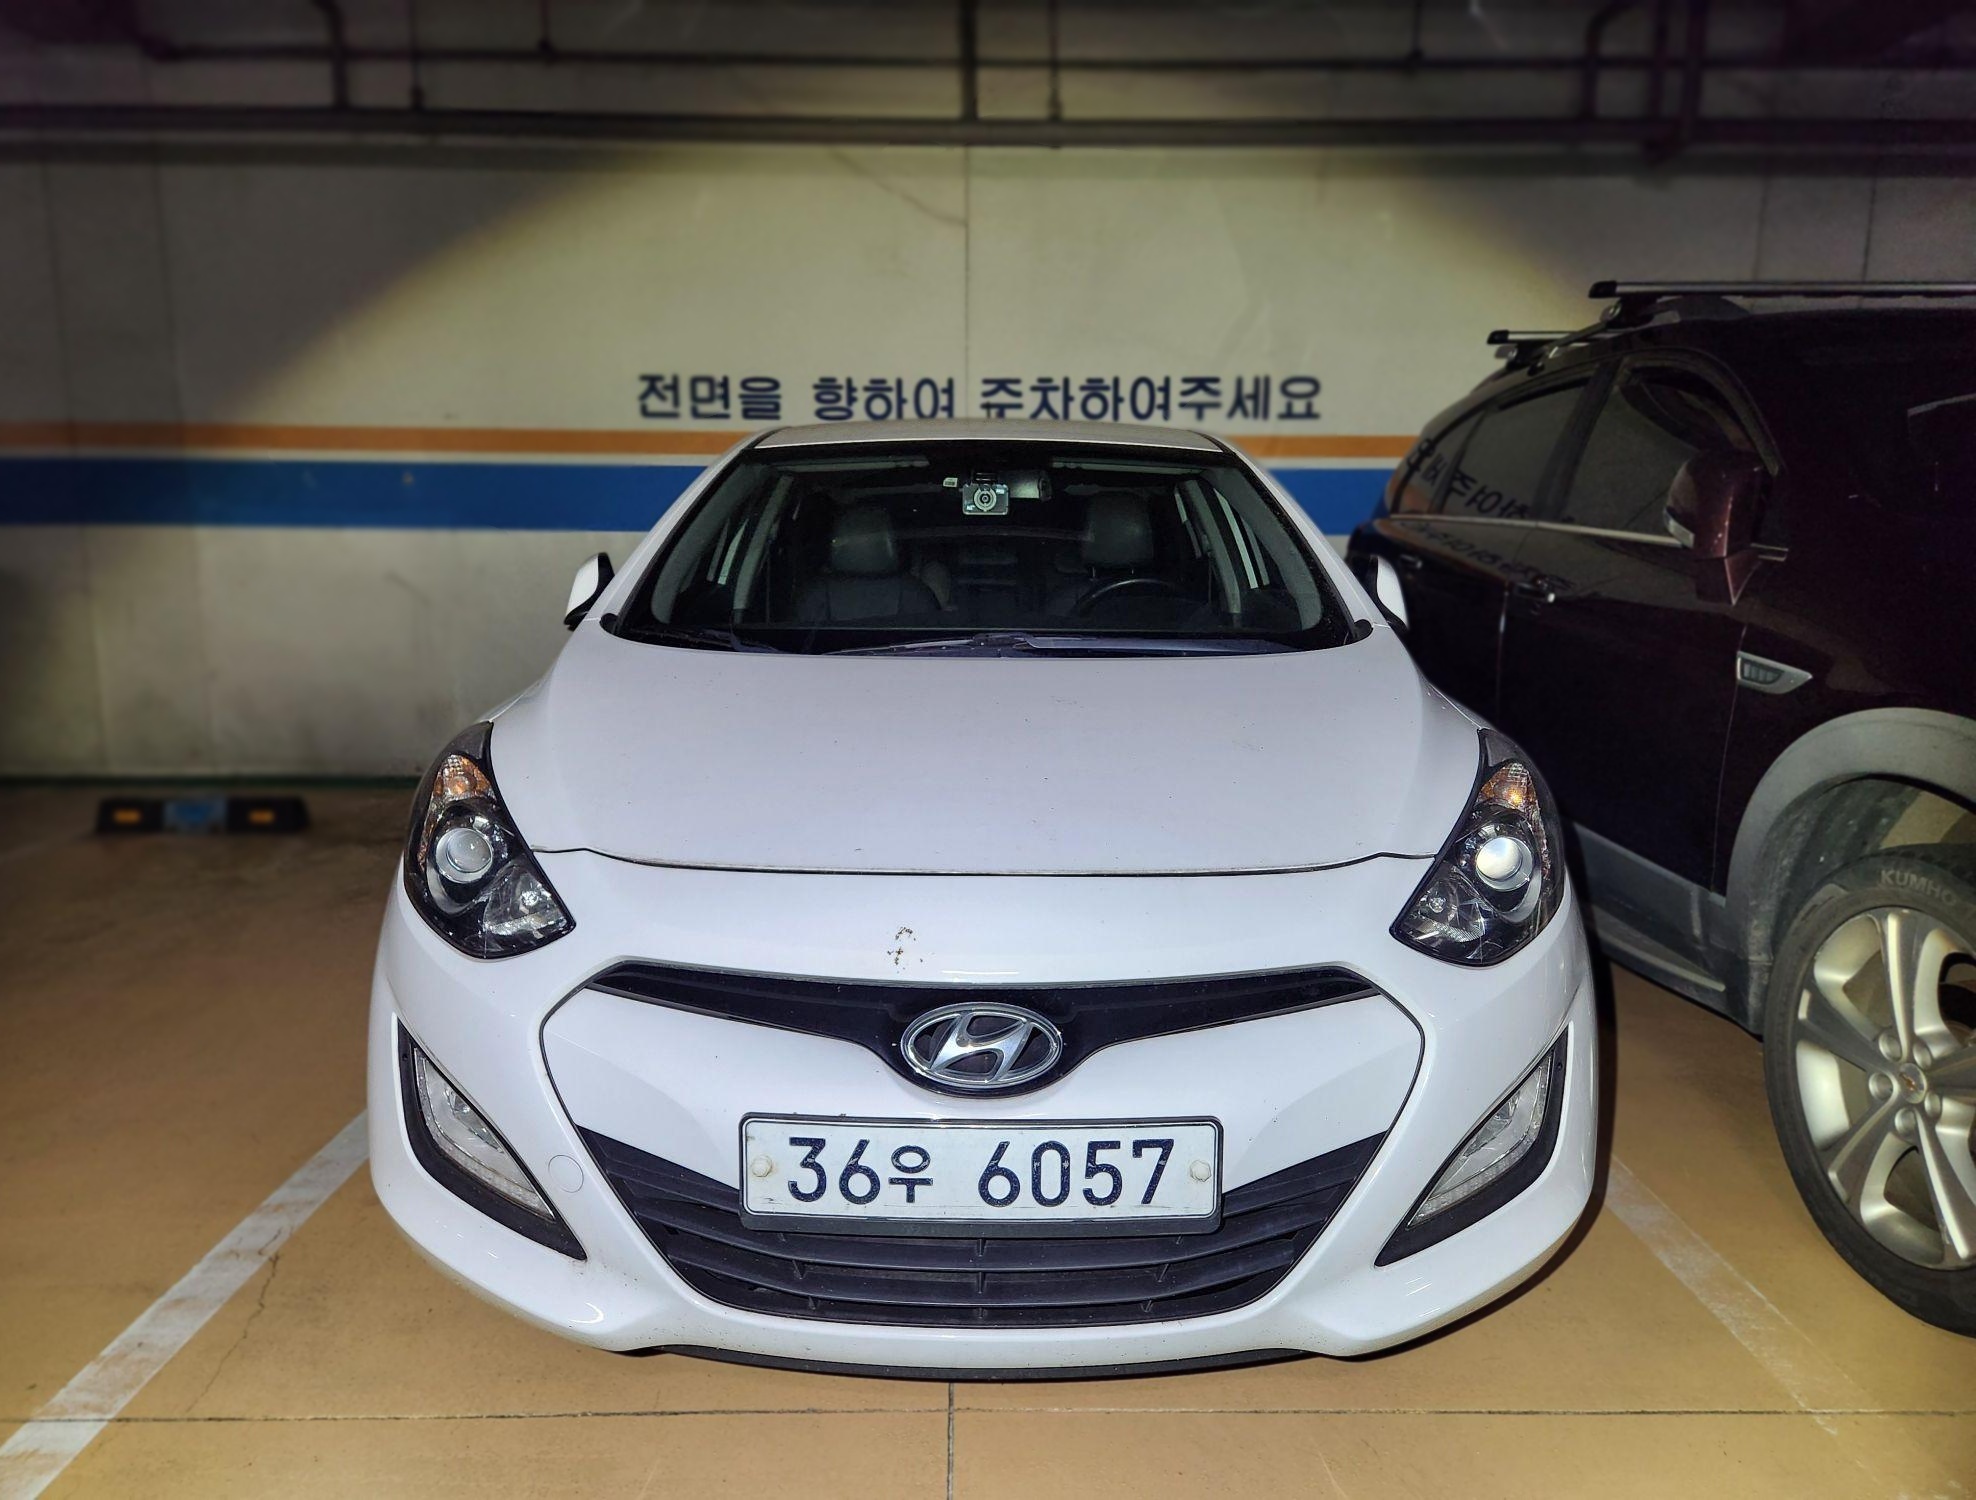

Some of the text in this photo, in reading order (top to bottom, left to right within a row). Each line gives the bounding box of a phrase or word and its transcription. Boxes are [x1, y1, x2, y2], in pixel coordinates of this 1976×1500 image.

[638, 373, 782, 421] 전면을
[812, 376, 955, 421] 향하여
[1879, 867, 1957, 906] KUMHO
[787, 1136, 1175, 1208] 36우 6057
